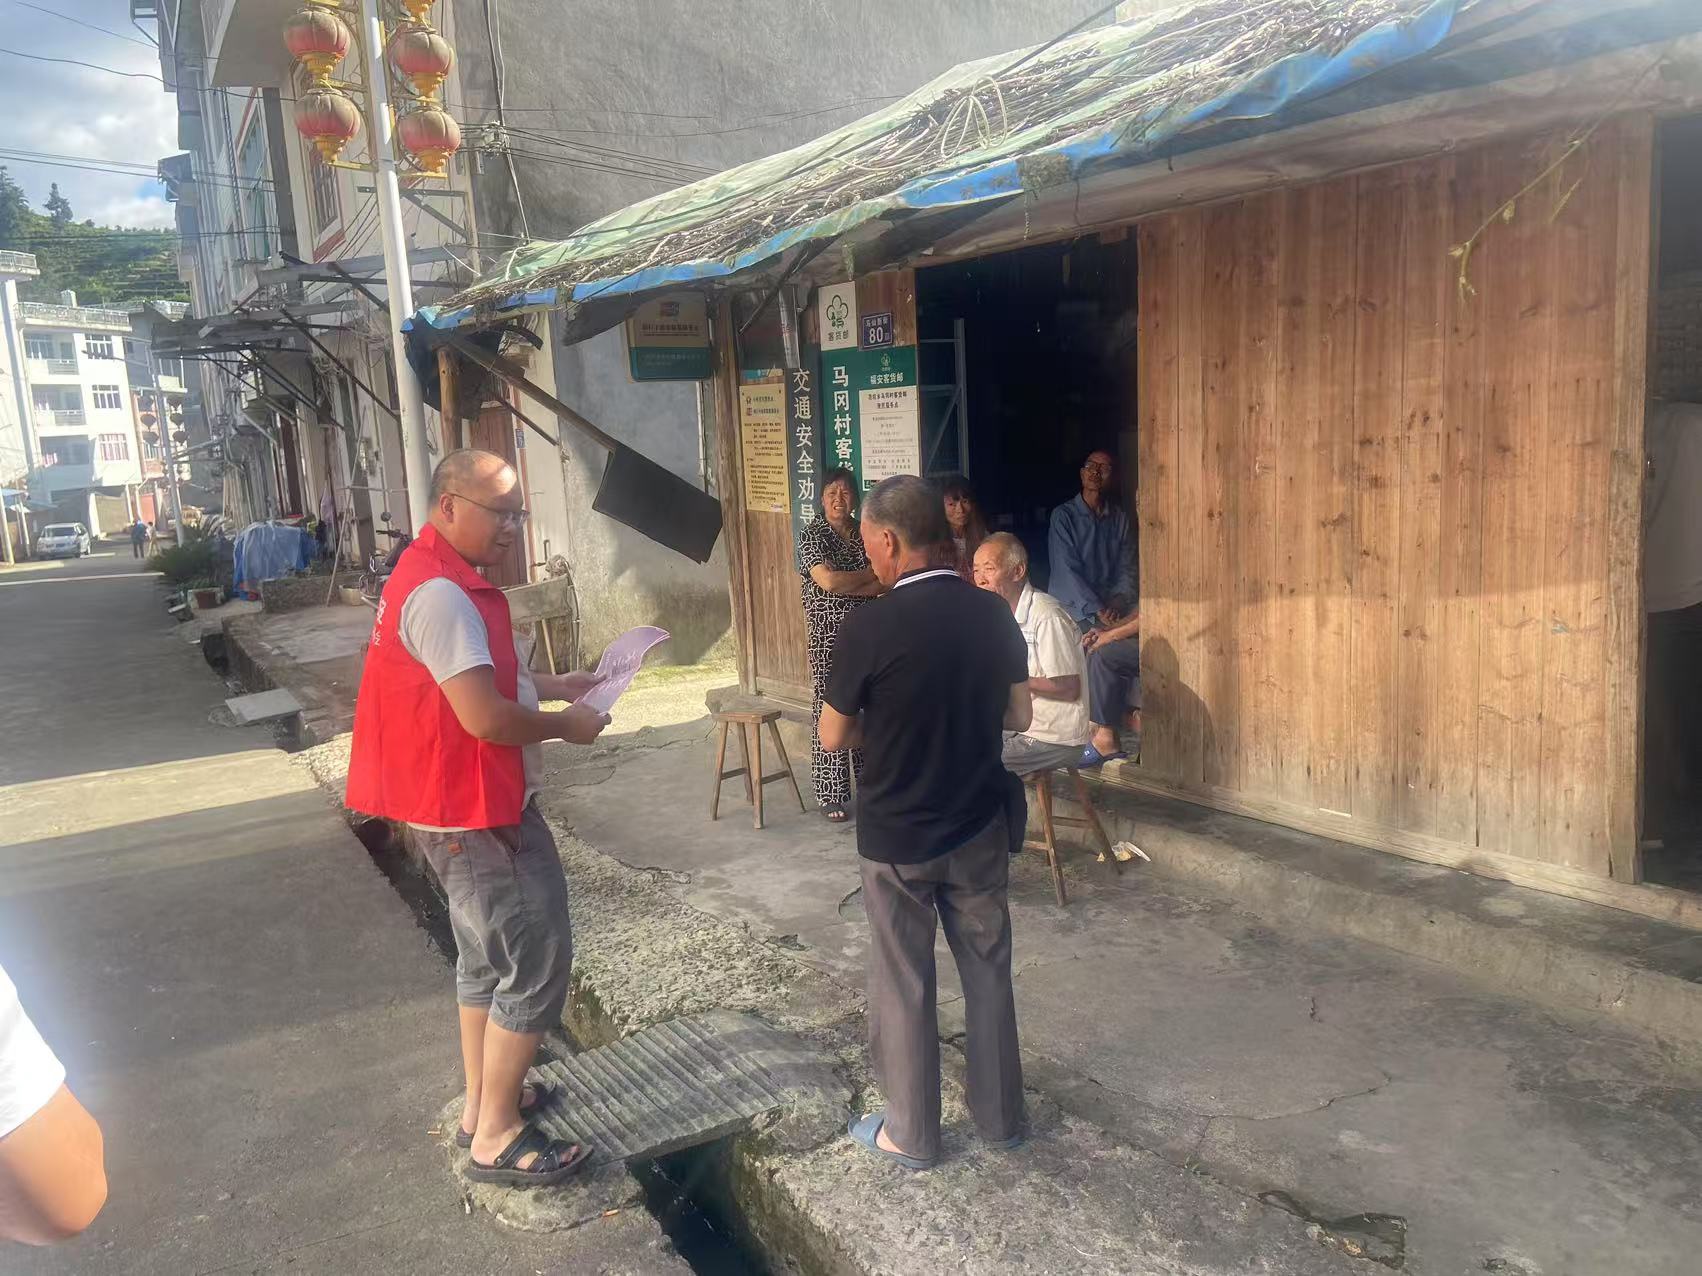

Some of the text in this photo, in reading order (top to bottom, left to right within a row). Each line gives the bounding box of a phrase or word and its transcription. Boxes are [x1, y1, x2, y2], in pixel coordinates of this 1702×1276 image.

[869, 326, 883, 343] 80
[870, 372, 904, 385] 福安客货邮
[793, 368, 815, 524] 交通安全劝导
